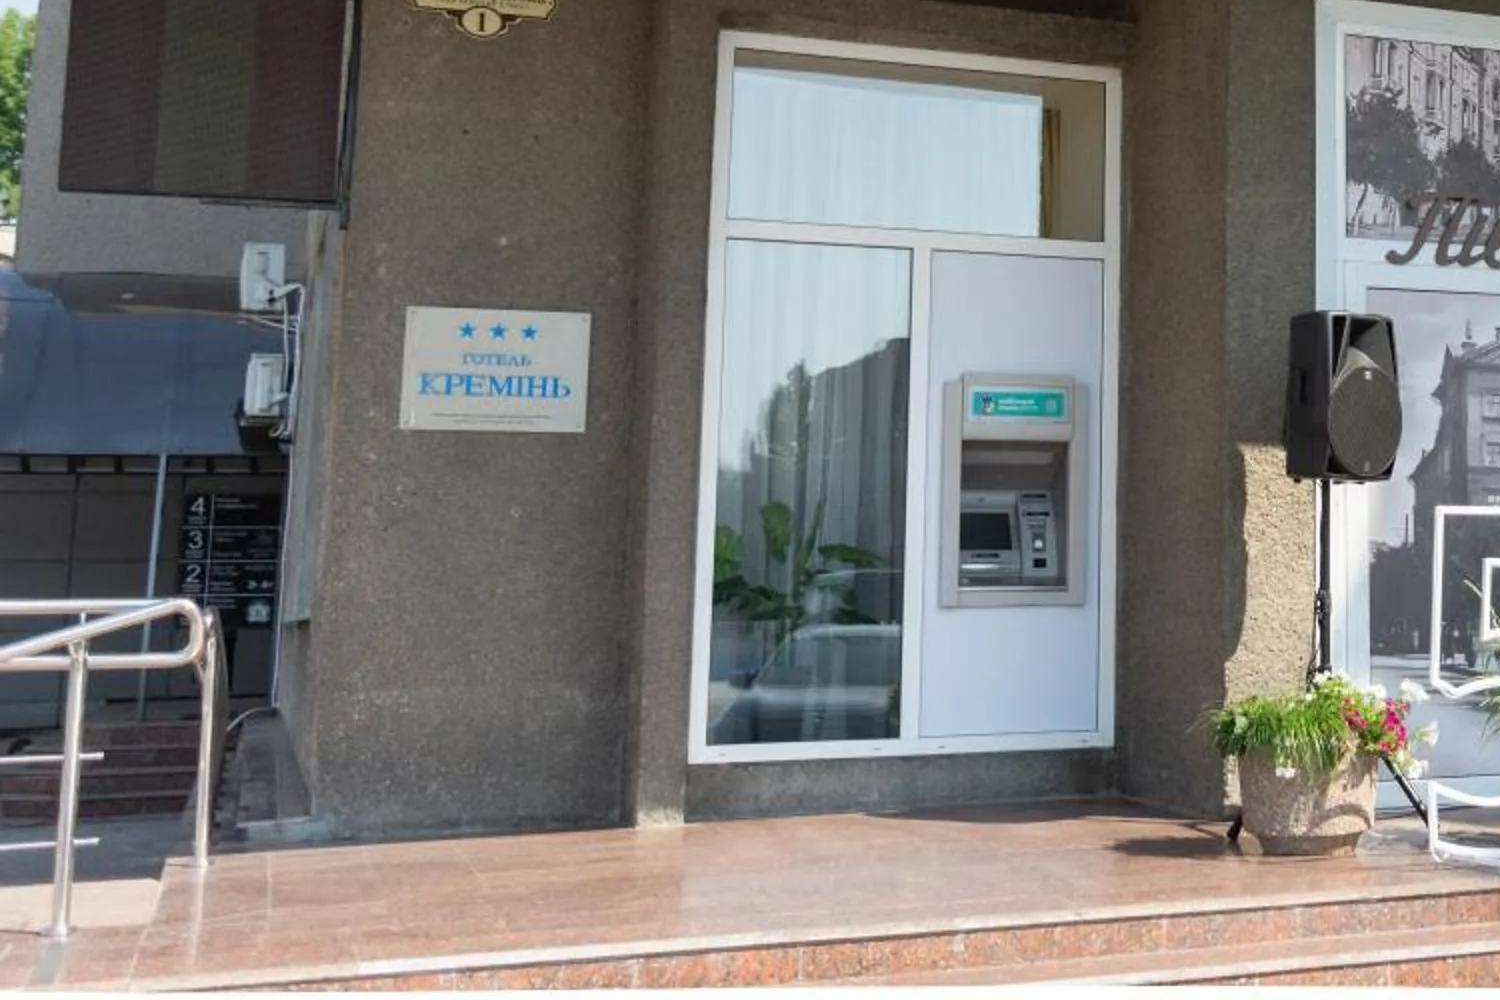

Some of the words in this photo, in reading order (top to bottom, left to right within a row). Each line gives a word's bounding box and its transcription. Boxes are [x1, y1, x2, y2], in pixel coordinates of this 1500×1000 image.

[478, 12, 486, 33] 1
[462, 352, 532, 367] ГОТЕЛЬ
[418, 372, 572, 399] КРЕМІНЬ
[190, 496, 206, 516] 4
[188, 530, 204, 549] 3
[185, 563, 202, 583] 2
